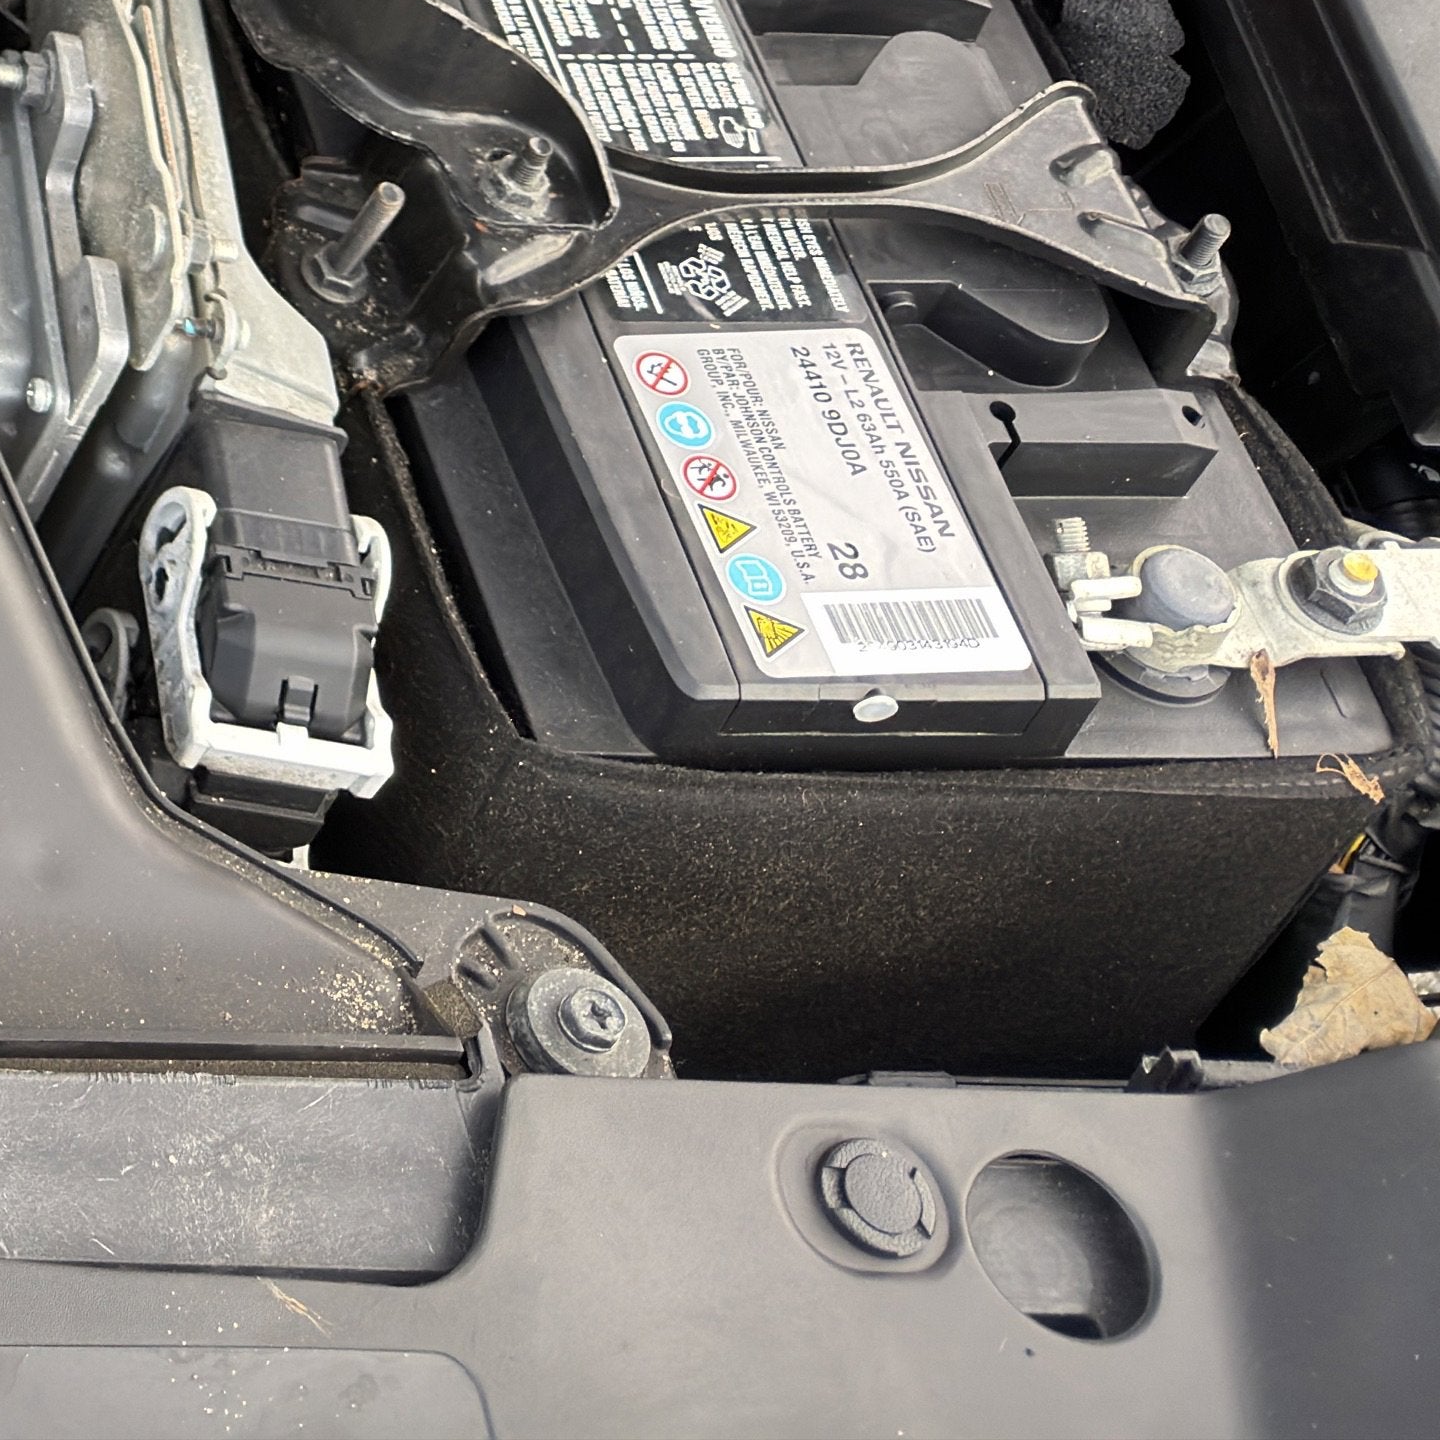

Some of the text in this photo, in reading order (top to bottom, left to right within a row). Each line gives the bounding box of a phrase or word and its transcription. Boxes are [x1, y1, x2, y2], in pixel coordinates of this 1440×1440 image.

[778, 261, 801, 283] HELP
[693, 349, 725, 388] GROUP,
[724, 347, 766, 407] FOR/POUR:
[754, 409, 786, 450] NISSAN
[788, 346, 870, 475] 24410 9DJ0A
[709, 348, 742, 390] BY/PAR:
[730, 392, 767, 443] JOHNSON
[756, 446, 797, 506] CONTROLS
[784, 508, 822, 559] BATTERY
[726, 419, 773, 488] MILWAUKEE,
[820, 343, 938, 553] 12V L2 63Ah 550A (SAE)
[844, 342, 956, 537] RENAULT NISSAN
[762, 491, 781, 506] WI
[768, 508, 800, 546] 53209,
[788, 550, 819, 584] U.S.A.
[824, 541, 872, 581] 28
